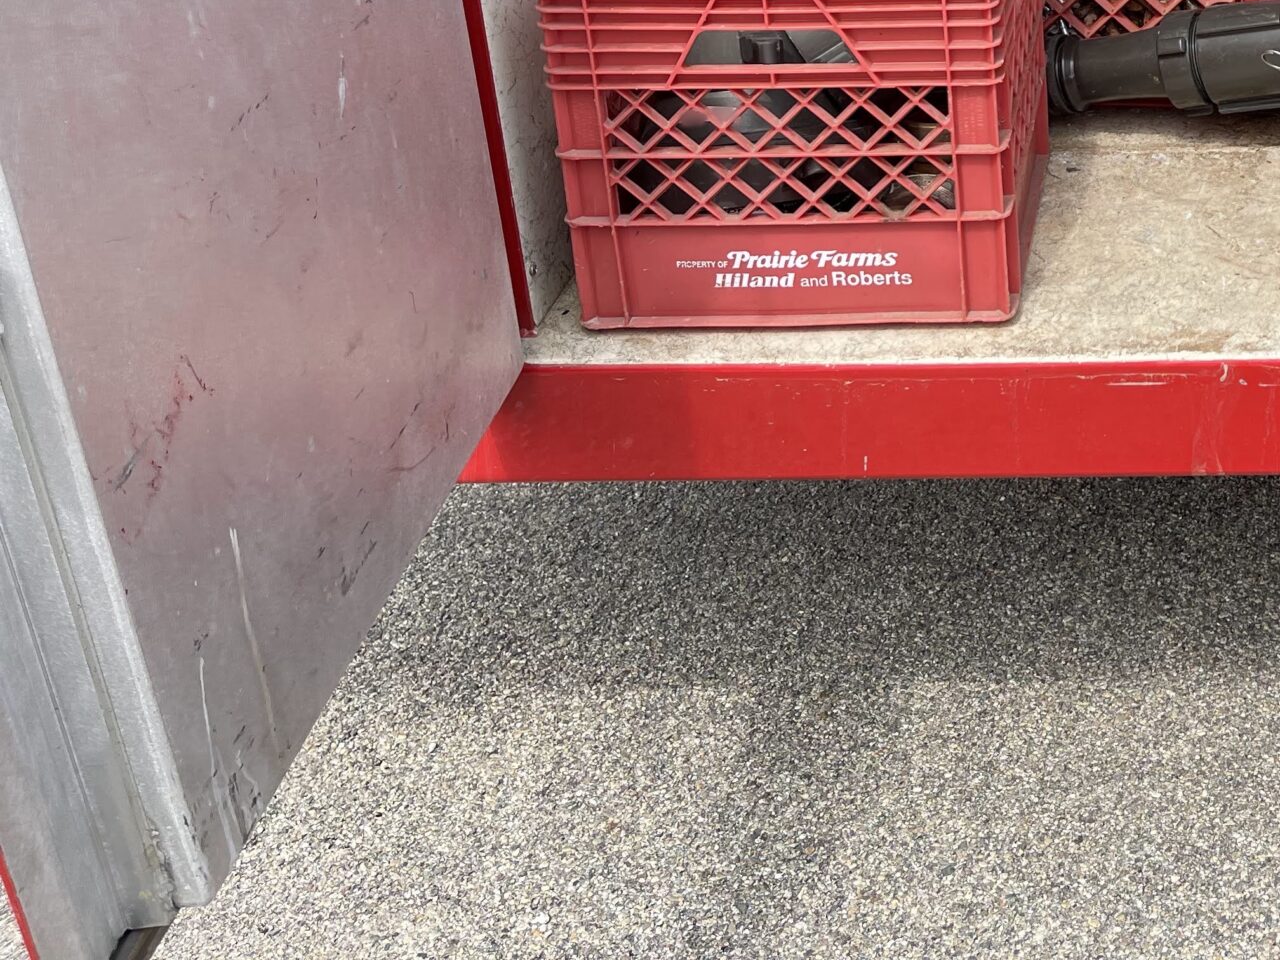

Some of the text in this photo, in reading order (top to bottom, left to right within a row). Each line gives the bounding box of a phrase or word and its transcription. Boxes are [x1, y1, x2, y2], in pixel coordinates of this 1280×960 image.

[727, 250, 809, 269] Prairie
[810, 250, 898, 268] Farms
[714, 270, 912, 288] Hiland and Roberts
